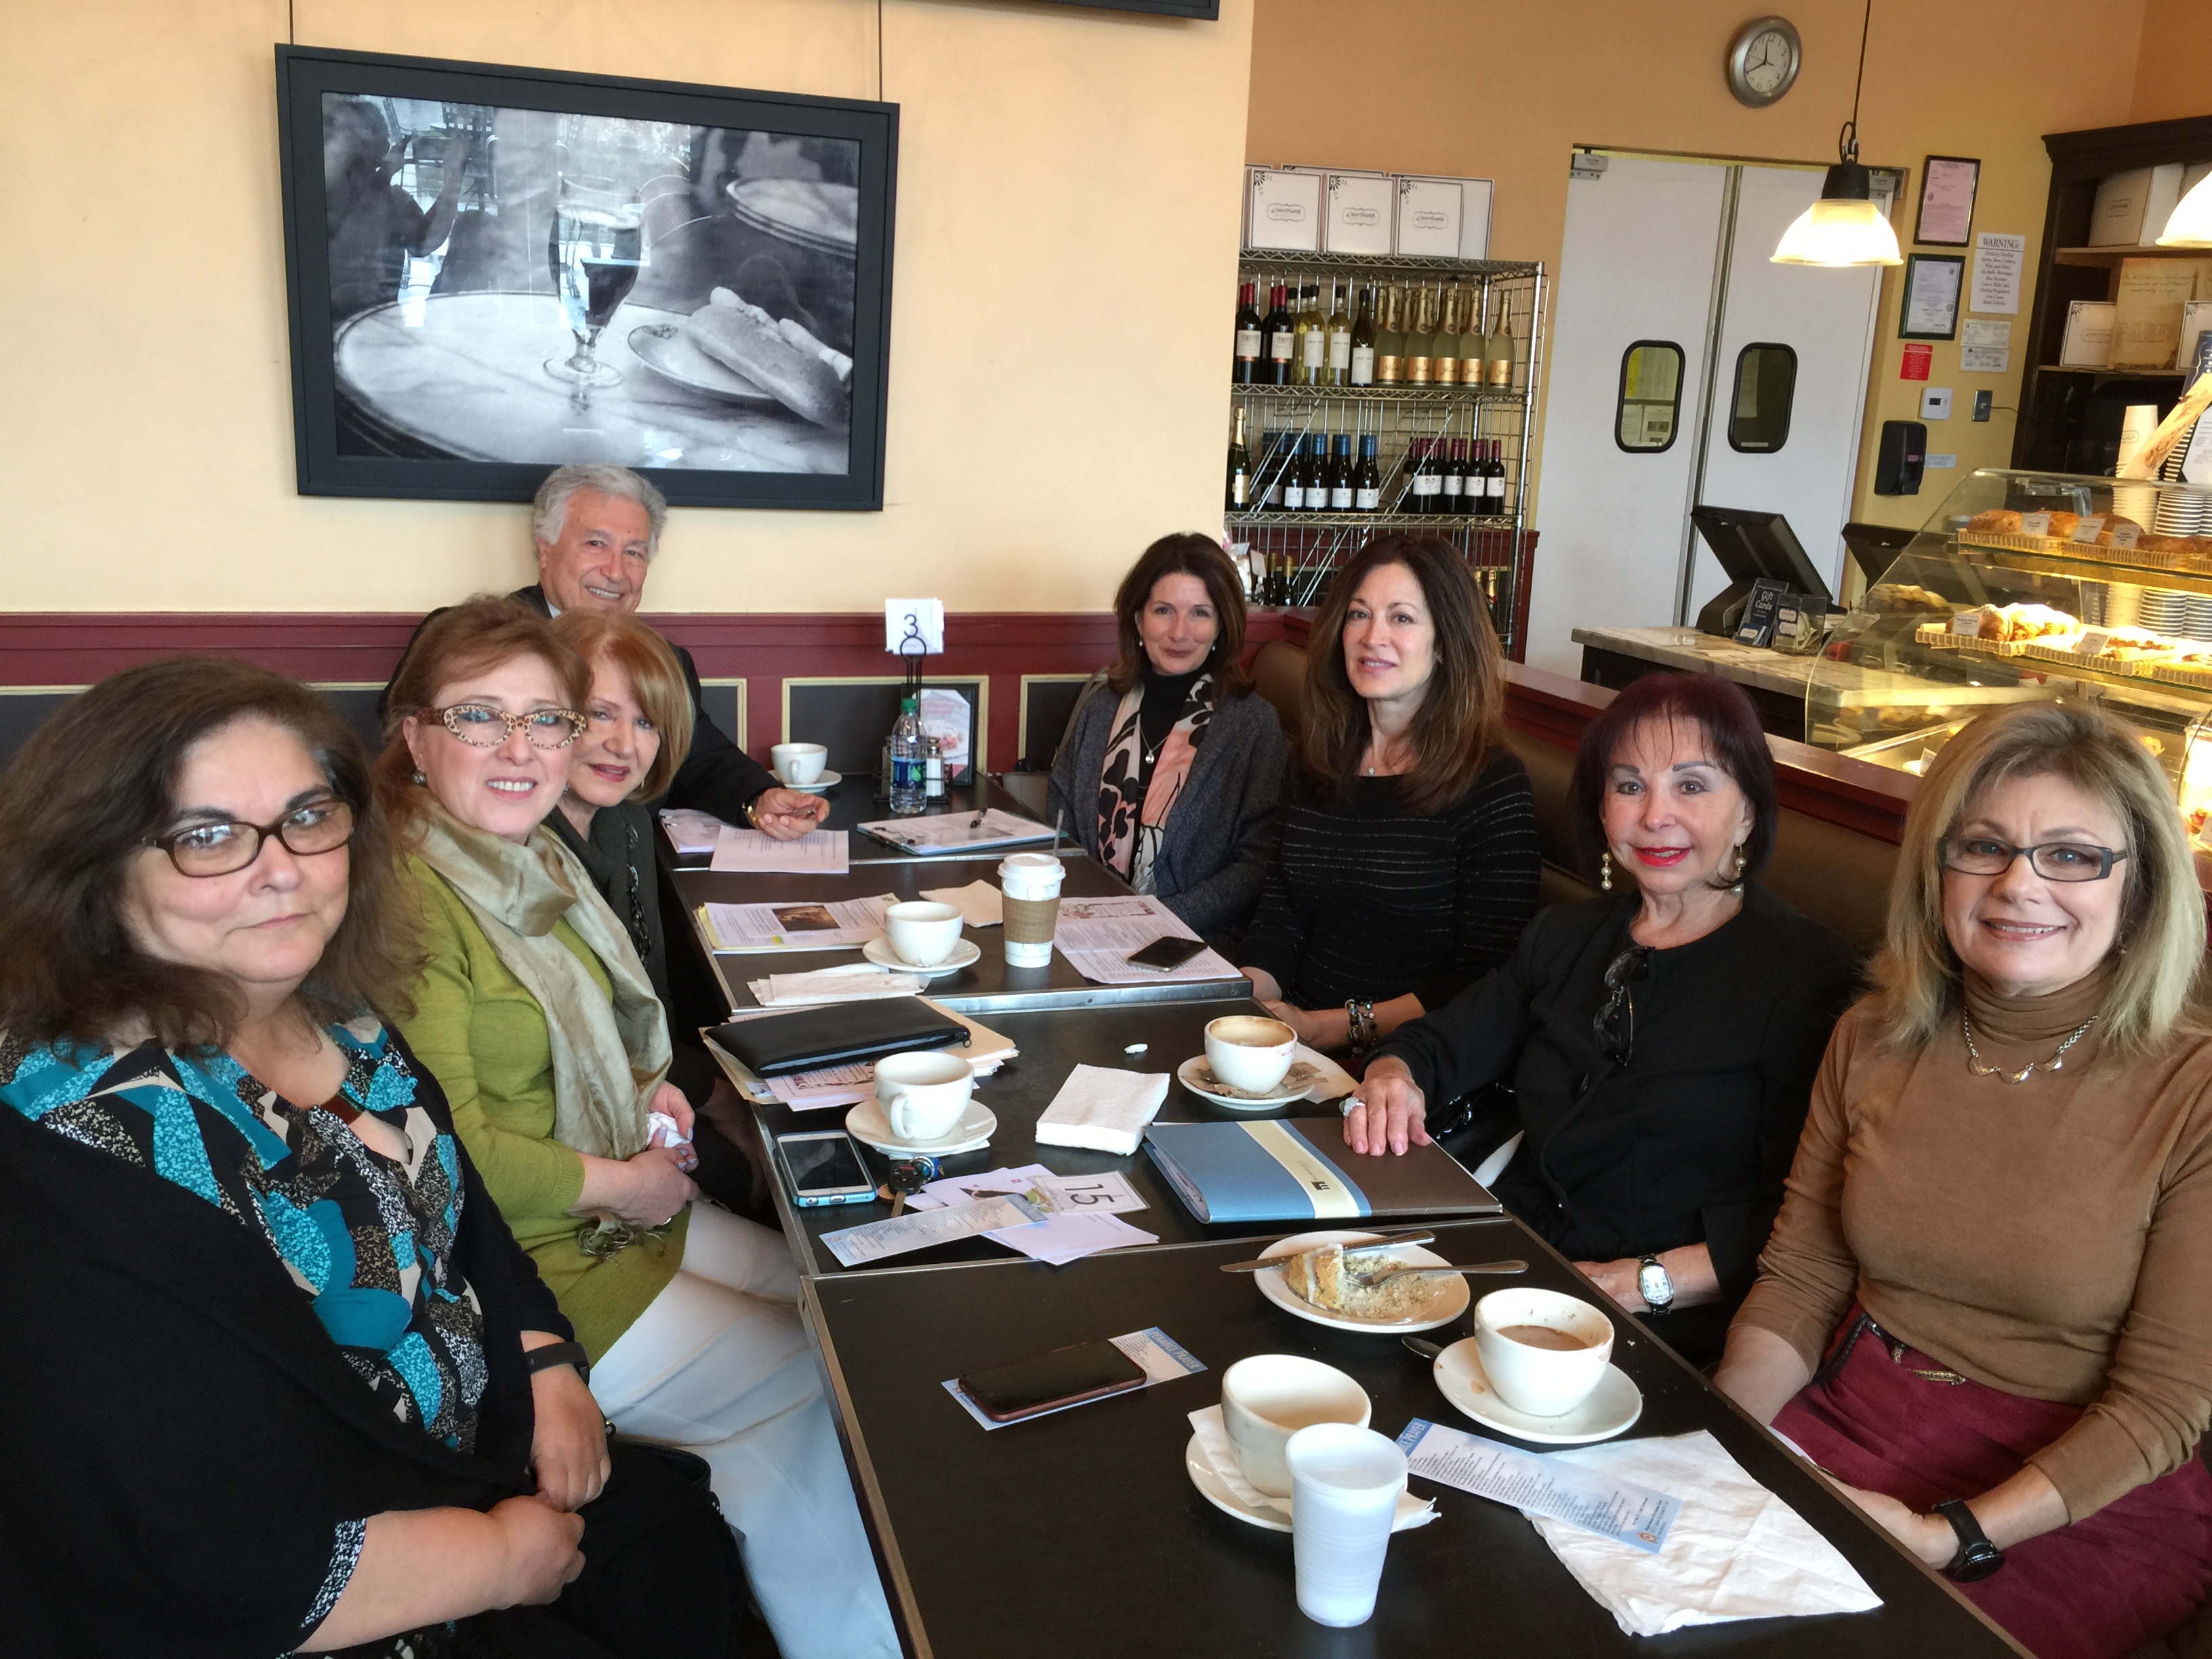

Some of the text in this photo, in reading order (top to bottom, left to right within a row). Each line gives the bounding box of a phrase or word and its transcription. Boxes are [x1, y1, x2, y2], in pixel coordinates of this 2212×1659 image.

[1755, 600, 1773, 611] Cards
[903, 613, 918, 638] 3
[1065, 1184, 1115, 1205] 15
[1151, 1331, 1178, 1353] PENANCE
[1173, 1351, 1200, 1369] PRAYER
[1404, 1422, 1427, 1442] PRAYER
